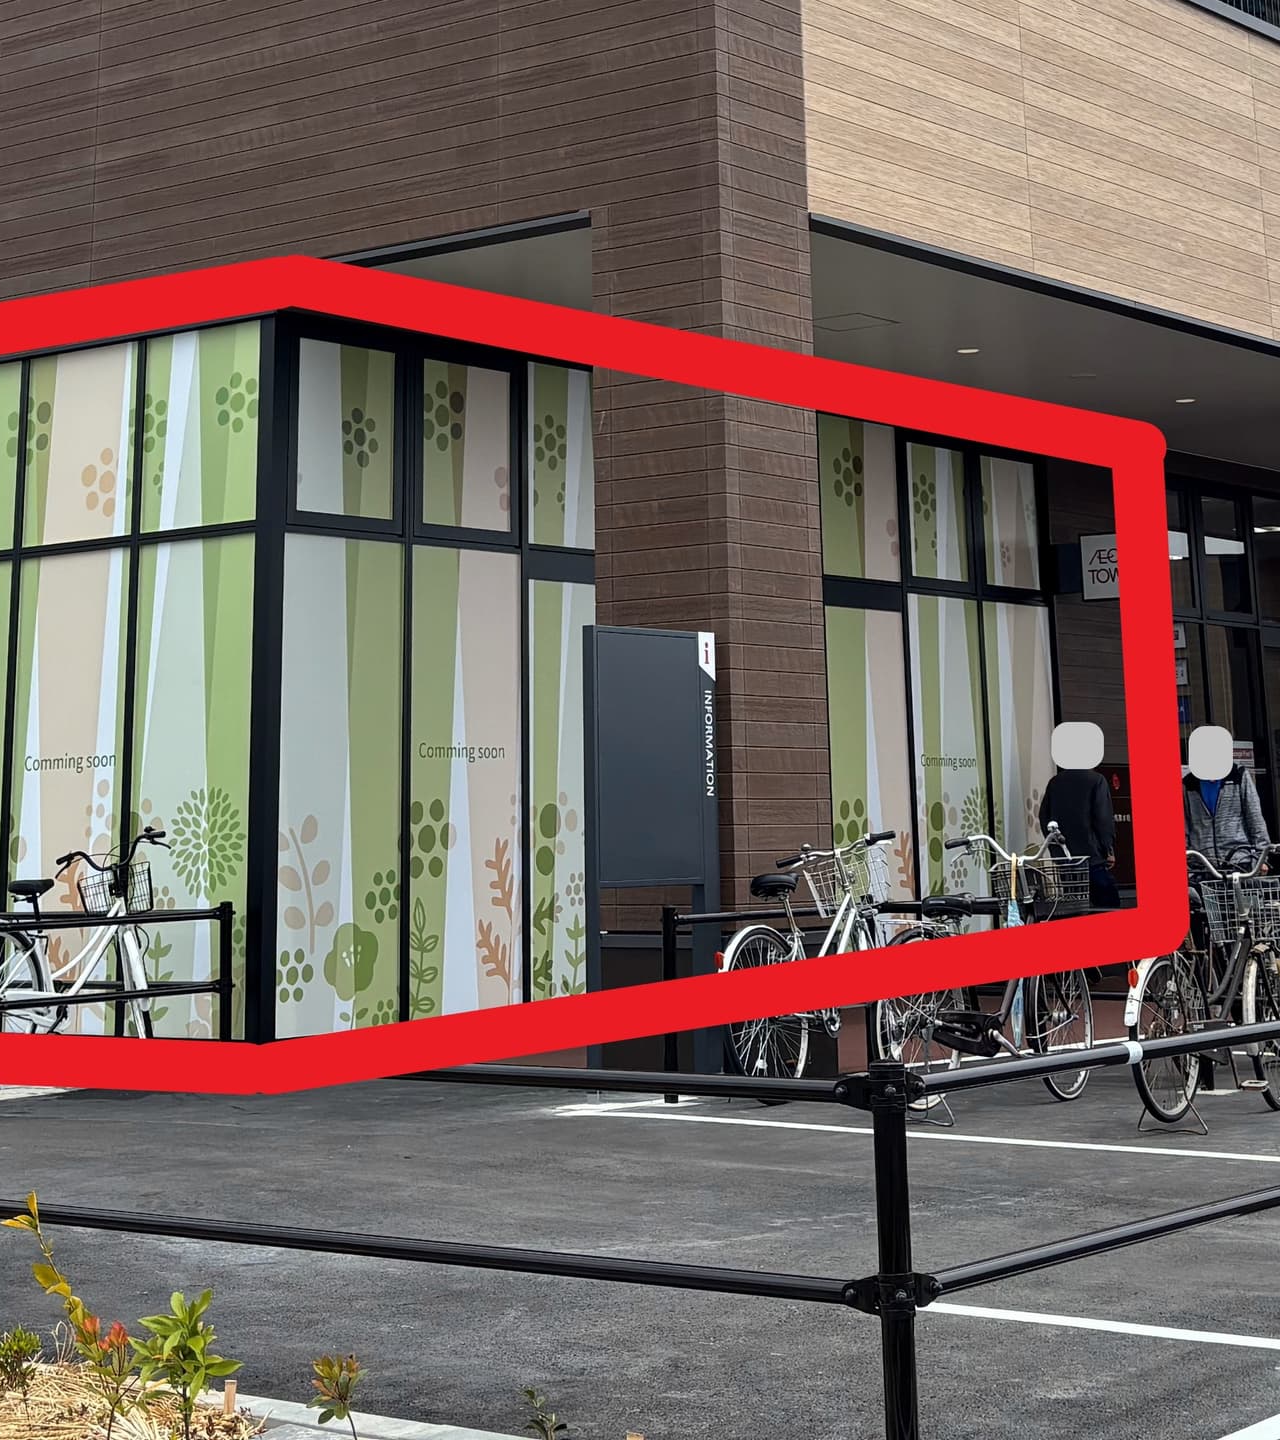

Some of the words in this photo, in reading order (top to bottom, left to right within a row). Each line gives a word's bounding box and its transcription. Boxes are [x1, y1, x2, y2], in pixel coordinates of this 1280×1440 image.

[1087, 567, 1119, 584] TOW
[418, 741, 476, 763] Comming
[478, 746, 505, 759] soon
[703, 689, 715, 798] INFORMATION
[24, 752, 84, 774] Comming
[86, 754, 117, 769] soon
[920, 753, 958, 771] Comming
[958, 756, 977, 768] soon
